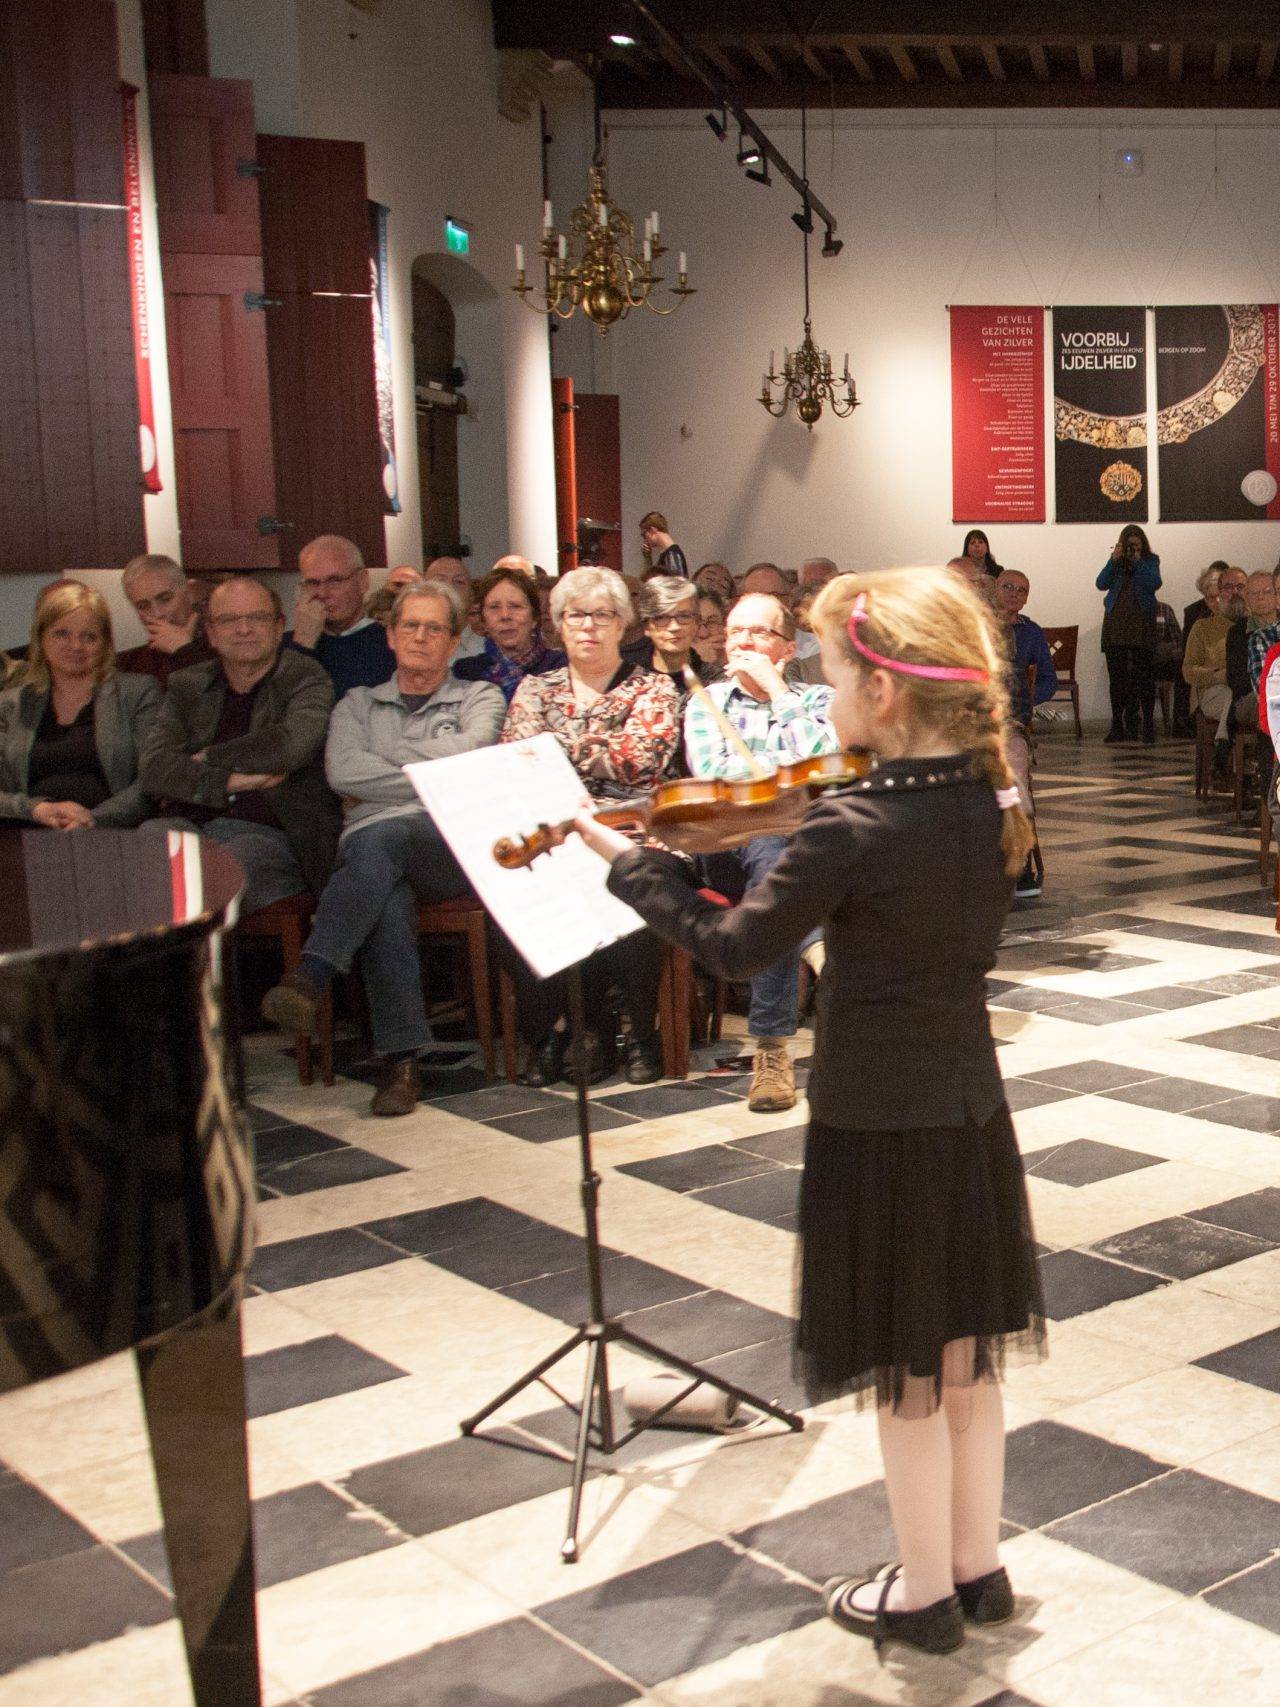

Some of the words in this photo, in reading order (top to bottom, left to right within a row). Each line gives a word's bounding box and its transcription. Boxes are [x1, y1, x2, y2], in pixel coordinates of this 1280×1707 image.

[132, 211, 142, 234] EN
[133, 239, 149, 359] SCHENKINGEN
[997, 316, 1008, 324] DE
[1011, 316, 1033, 324] VELE
[1267, 312, 1276, 335] 2017
[981, 327, 1033, 336] GEZICHTEN
[982, 338, 1001, 347] VAN
[1003, 338, 1034, 347] ZILVER
[1061, 332, 1130, 347] VOORBIJ
[1061, 355, 1137, 370] IJDELHEID
[1268, 336, 1277, 379] OKTOBER
[1268, 381, 1277, 392] 29
[1269, 394, 1278, 410] T/M
[1269, 413, 1278, 429] MEI
[1270, 430, 1278, 443] 20
